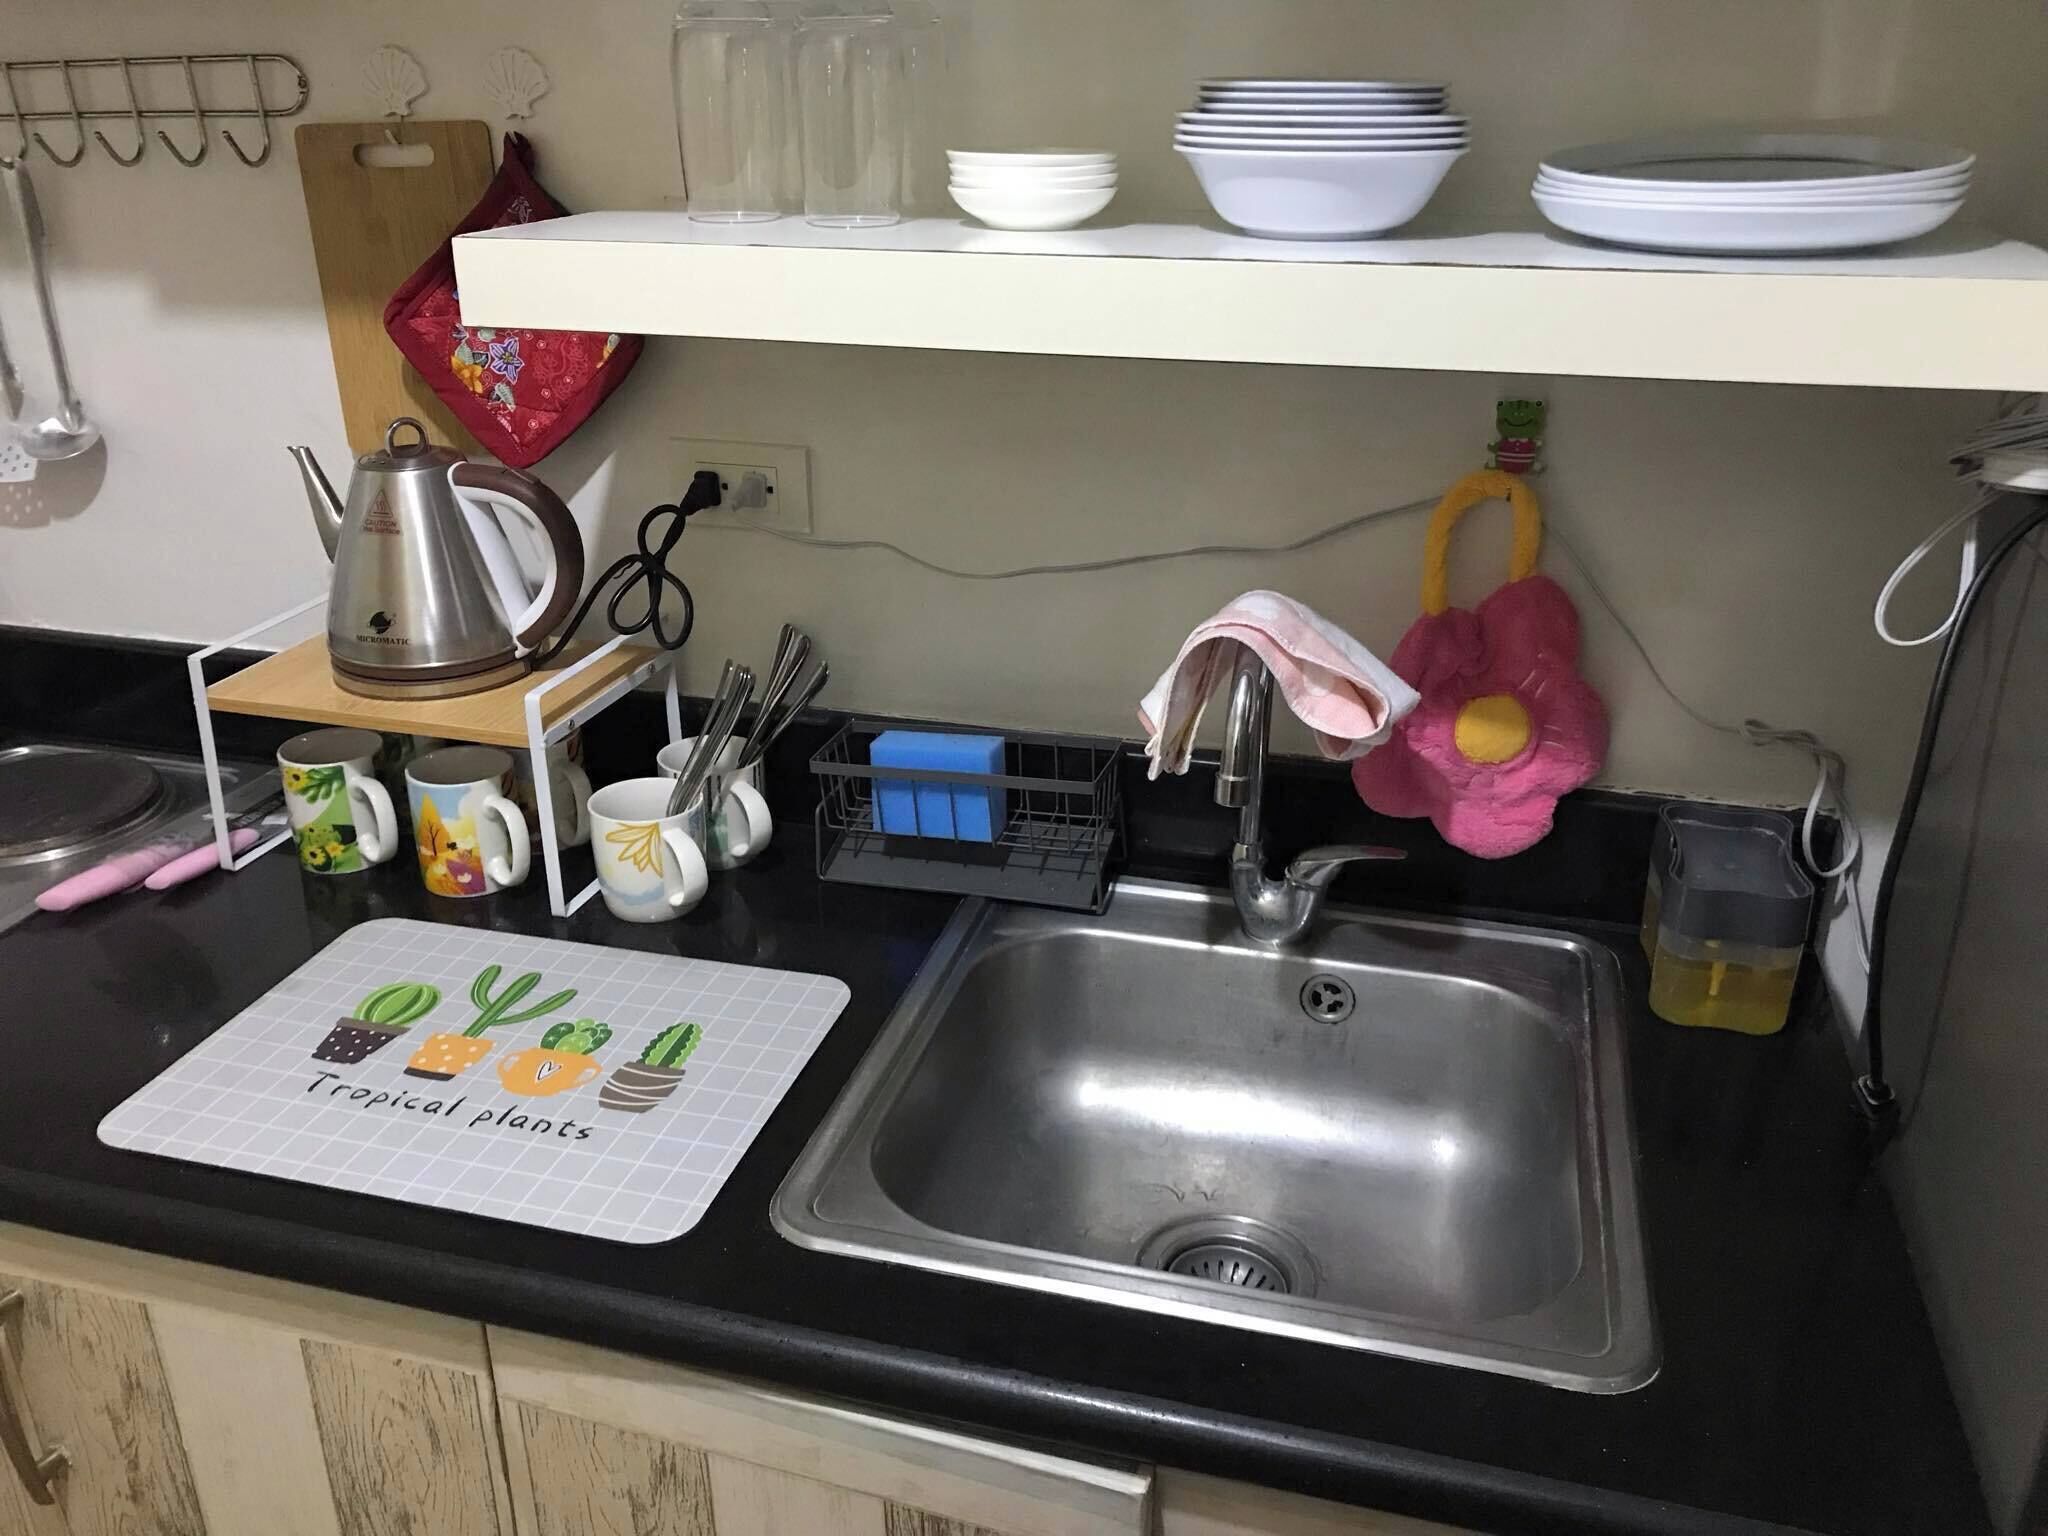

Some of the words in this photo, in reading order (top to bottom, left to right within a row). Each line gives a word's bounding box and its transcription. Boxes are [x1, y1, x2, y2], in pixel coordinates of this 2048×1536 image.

[356, 635, 409, 645] MICROMATIC
[307, 1071, 467, 1117] Tropical
[469, 1104, 595, 1141] plants
